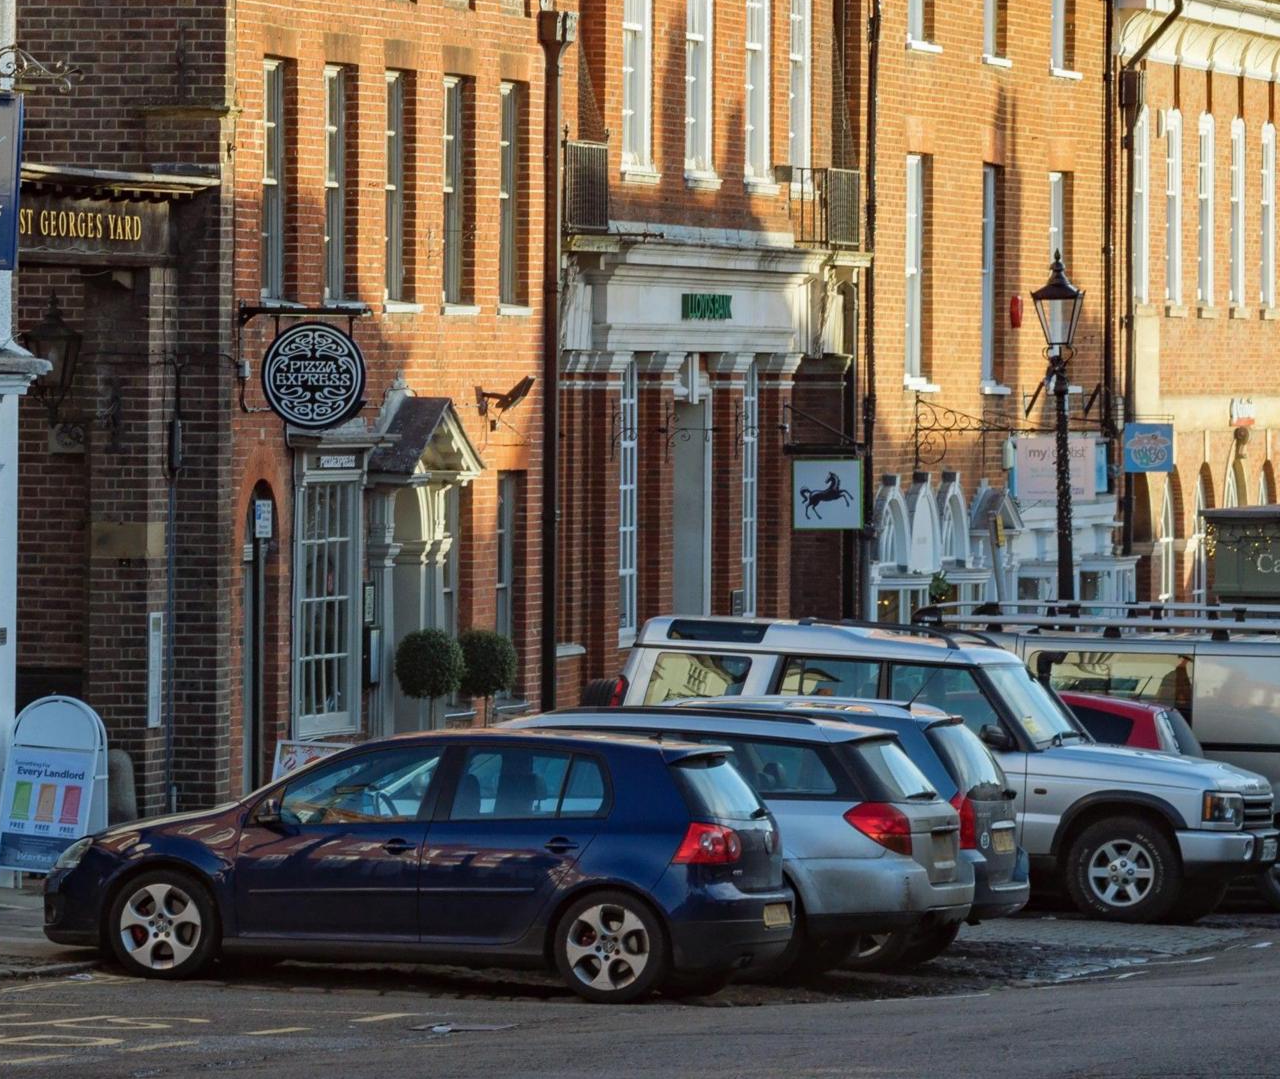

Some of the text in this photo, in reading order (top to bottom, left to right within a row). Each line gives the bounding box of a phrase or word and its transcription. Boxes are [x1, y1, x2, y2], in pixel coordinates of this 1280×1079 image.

[19, 208, 142, 241] ST GEORGES YARD
[688, 294, 715, 320] LLOYDS
[289, 361, 337, 373] PIZZA
[275, 373, 351, 386] EXPRESS
[17, 766, 86, 781] Every Landlord
[9, 821, 25, 829] FREE
